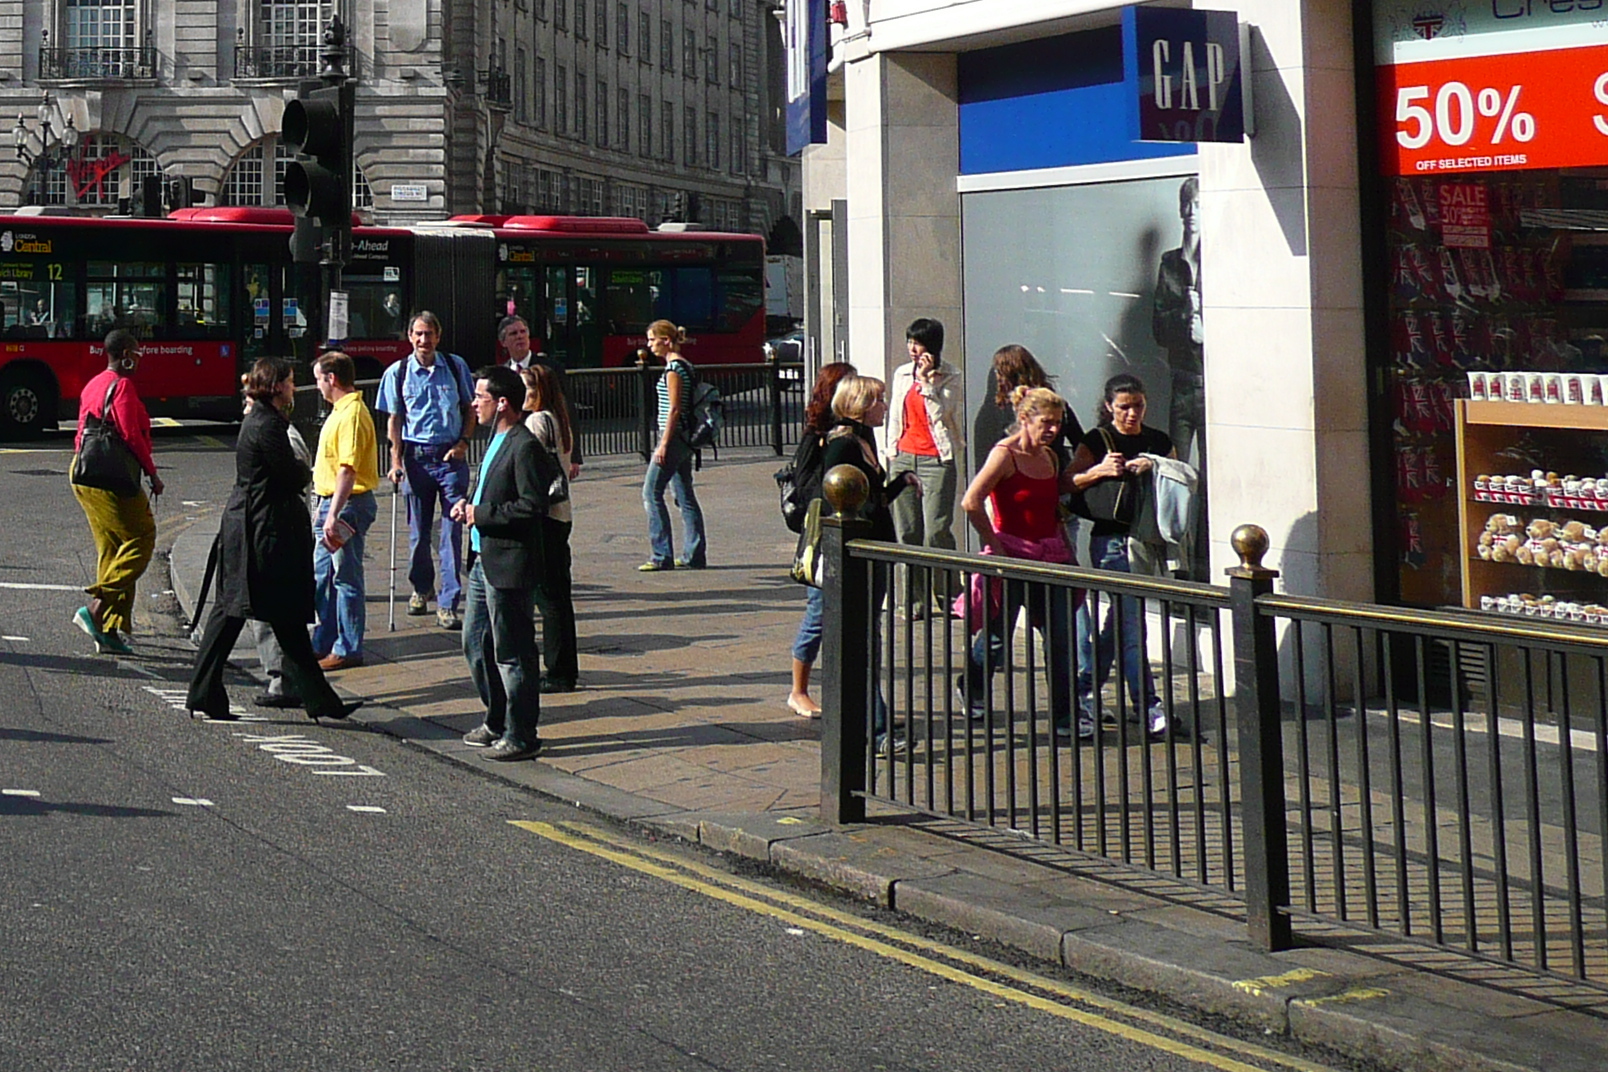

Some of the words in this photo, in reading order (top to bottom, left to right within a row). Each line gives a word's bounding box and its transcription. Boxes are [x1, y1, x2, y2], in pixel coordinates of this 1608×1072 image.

[1152, 39, 1225, 112] GAP
[1395, 81, 1536, 149] 50%
[1416, 158, 1437, 171] OFF
[1438, 155, 1492, 169] SELECTED
[1494, 154, 1527, 166] ITEMS
[1440, 185, 1485, 206] SALE
[14, 239, 52, 253] Central
[47, 263, 63, 280] 12
[89, 345, 104, 356] Buy
[160, 345, 193, 356] boarding
